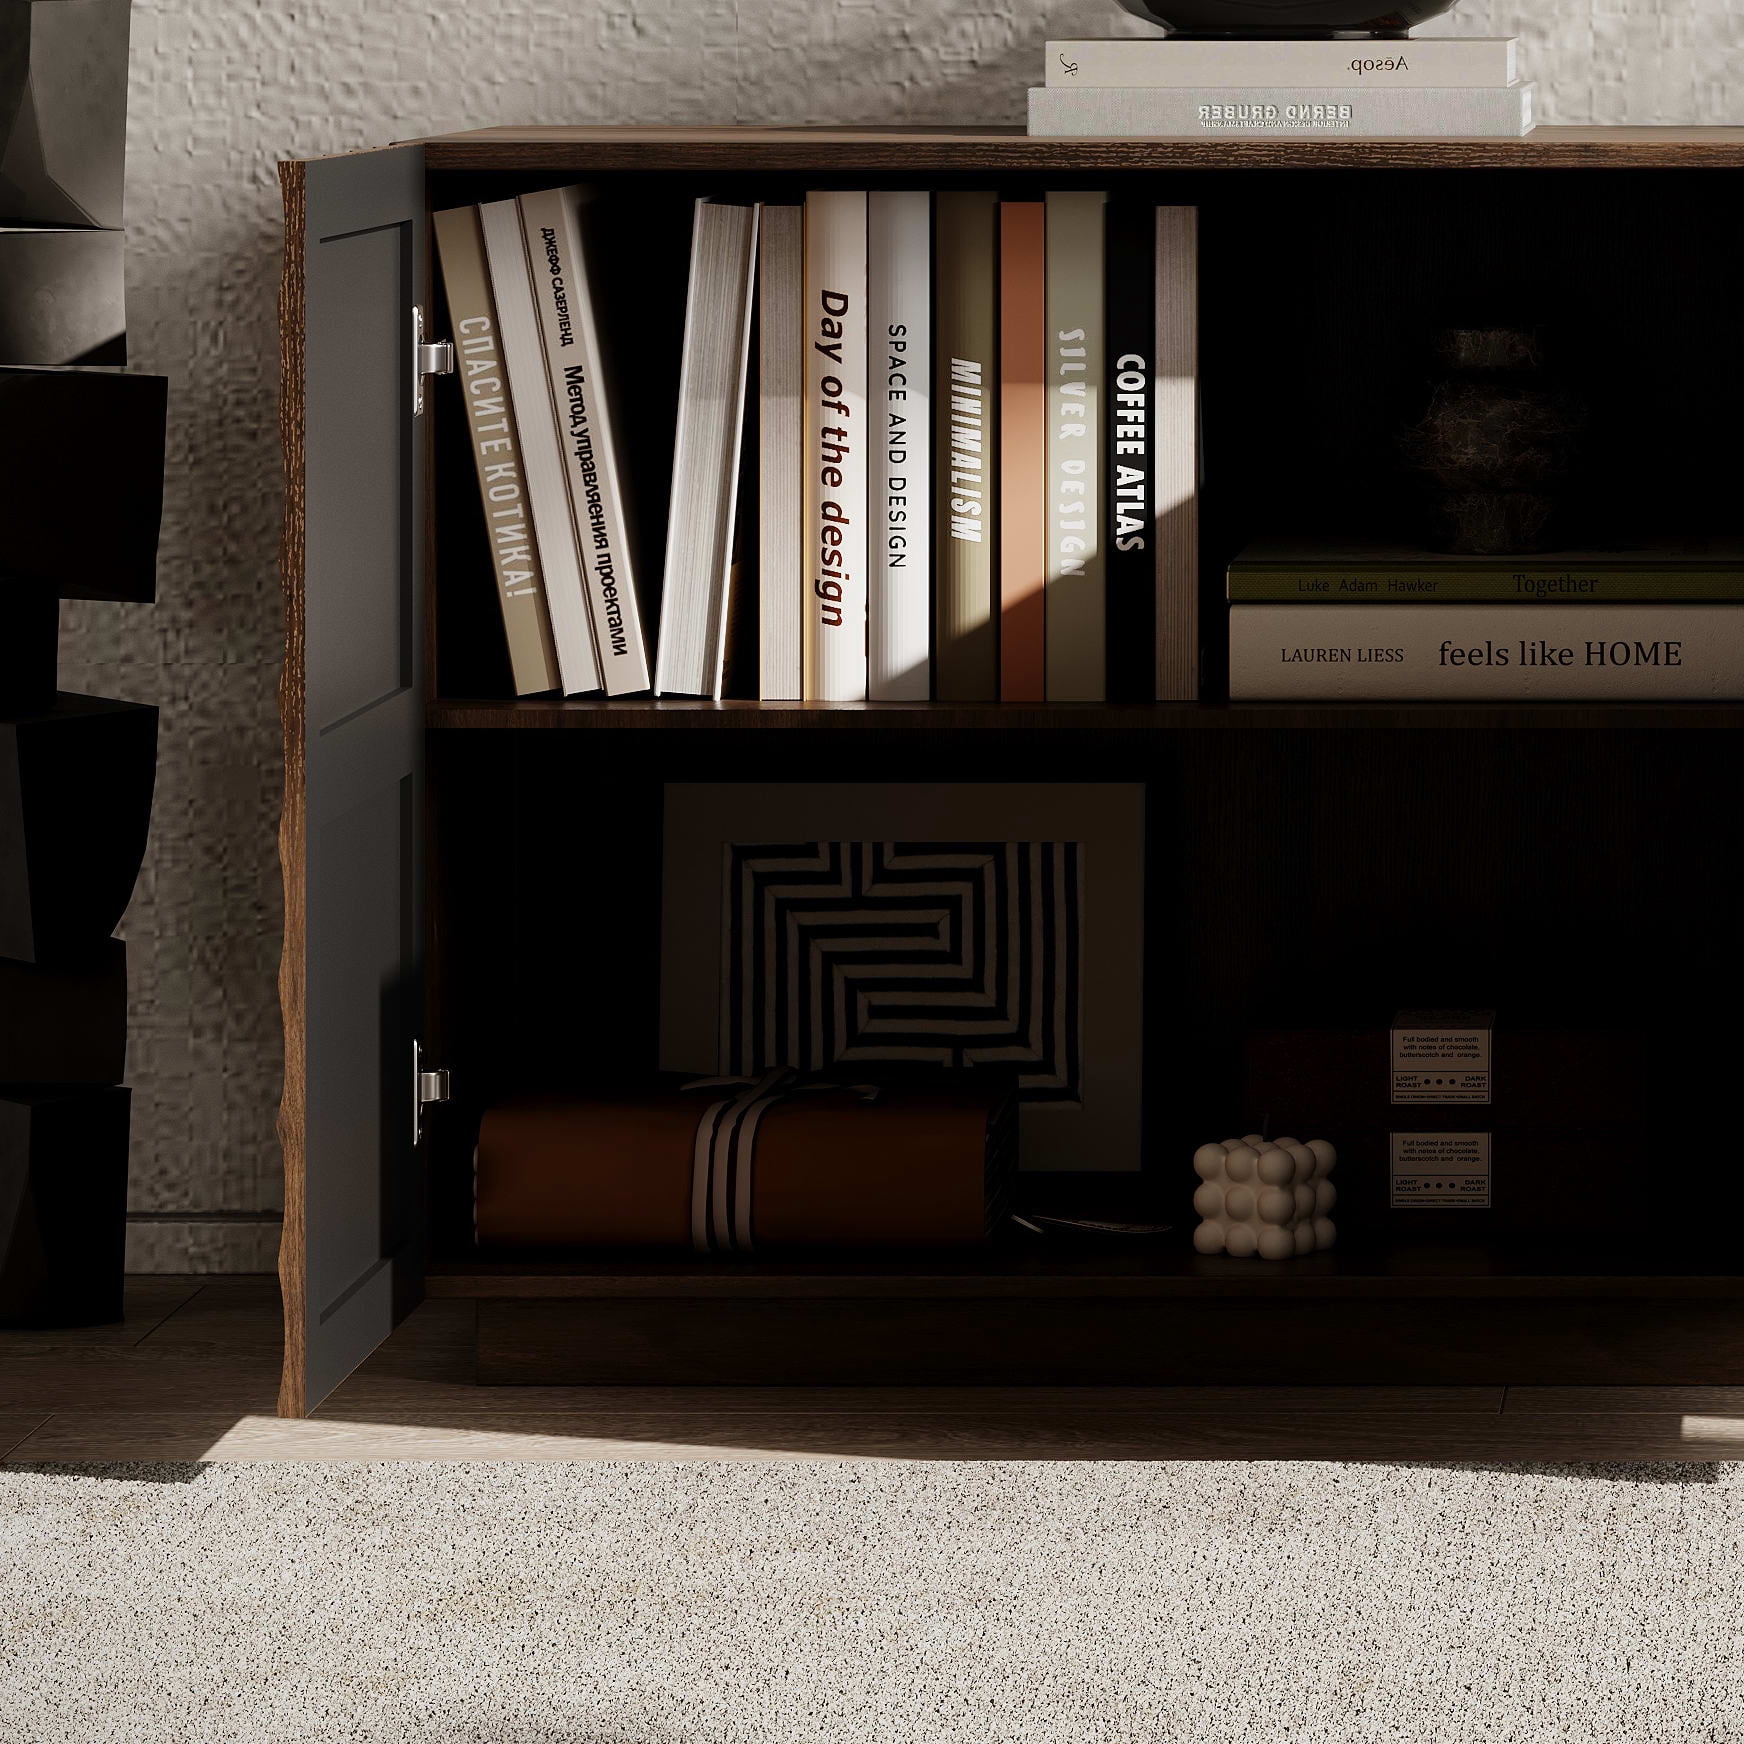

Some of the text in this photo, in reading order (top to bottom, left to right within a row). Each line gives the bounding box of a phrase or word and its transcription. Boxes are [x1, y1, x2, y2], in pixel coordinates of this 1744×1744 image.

[540, 227, 574, 347] ДЖЕФФ САЗЕРЛЕНД
[459, 315, 537, 598] СПАСИТЕ КОТИКА!
[564, 365, 587, 427] Метод
[595, 553, 628, 656] проектами
[815, 289, 850, 627] Day of the design
[889, 324, 907, 568] SPACE AND DESIGN
[951, 357, 981, 543] MINIMALISM
[1058, 328, 1086, 577] SILVER DESIGN
[1116, 354, 1145, 551] COFFEE ATLAS
[1281, 648, 1404, 663] LAUREN LIESS
[1298, 579, 1439, 592] Luke Adam Hawker
[1439, 641, 1682, 667] feels like HOME
[1513, 574, 1599, 597] Together
